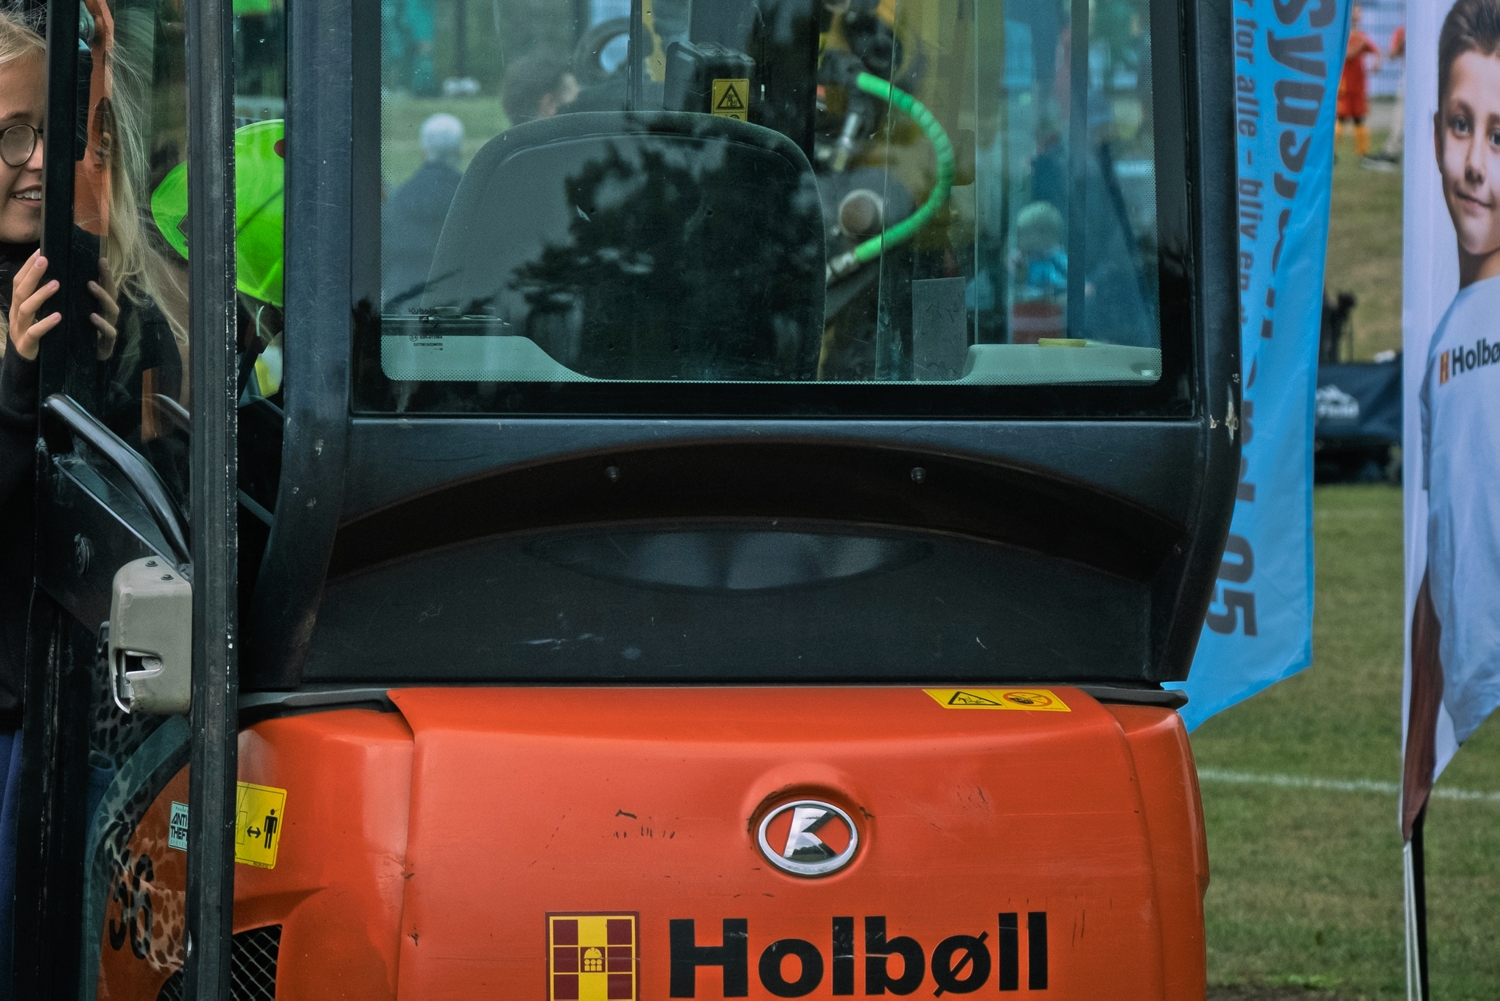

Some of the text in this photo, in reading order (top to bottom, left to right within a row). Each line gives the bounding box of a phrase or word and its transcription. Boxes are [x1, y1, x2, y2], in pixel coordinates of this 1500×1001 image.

[1235, 18, 1258, 64] for
[1236, 74, 1260, 138] alle
[669, 911, 1048, 999] Holbøll
